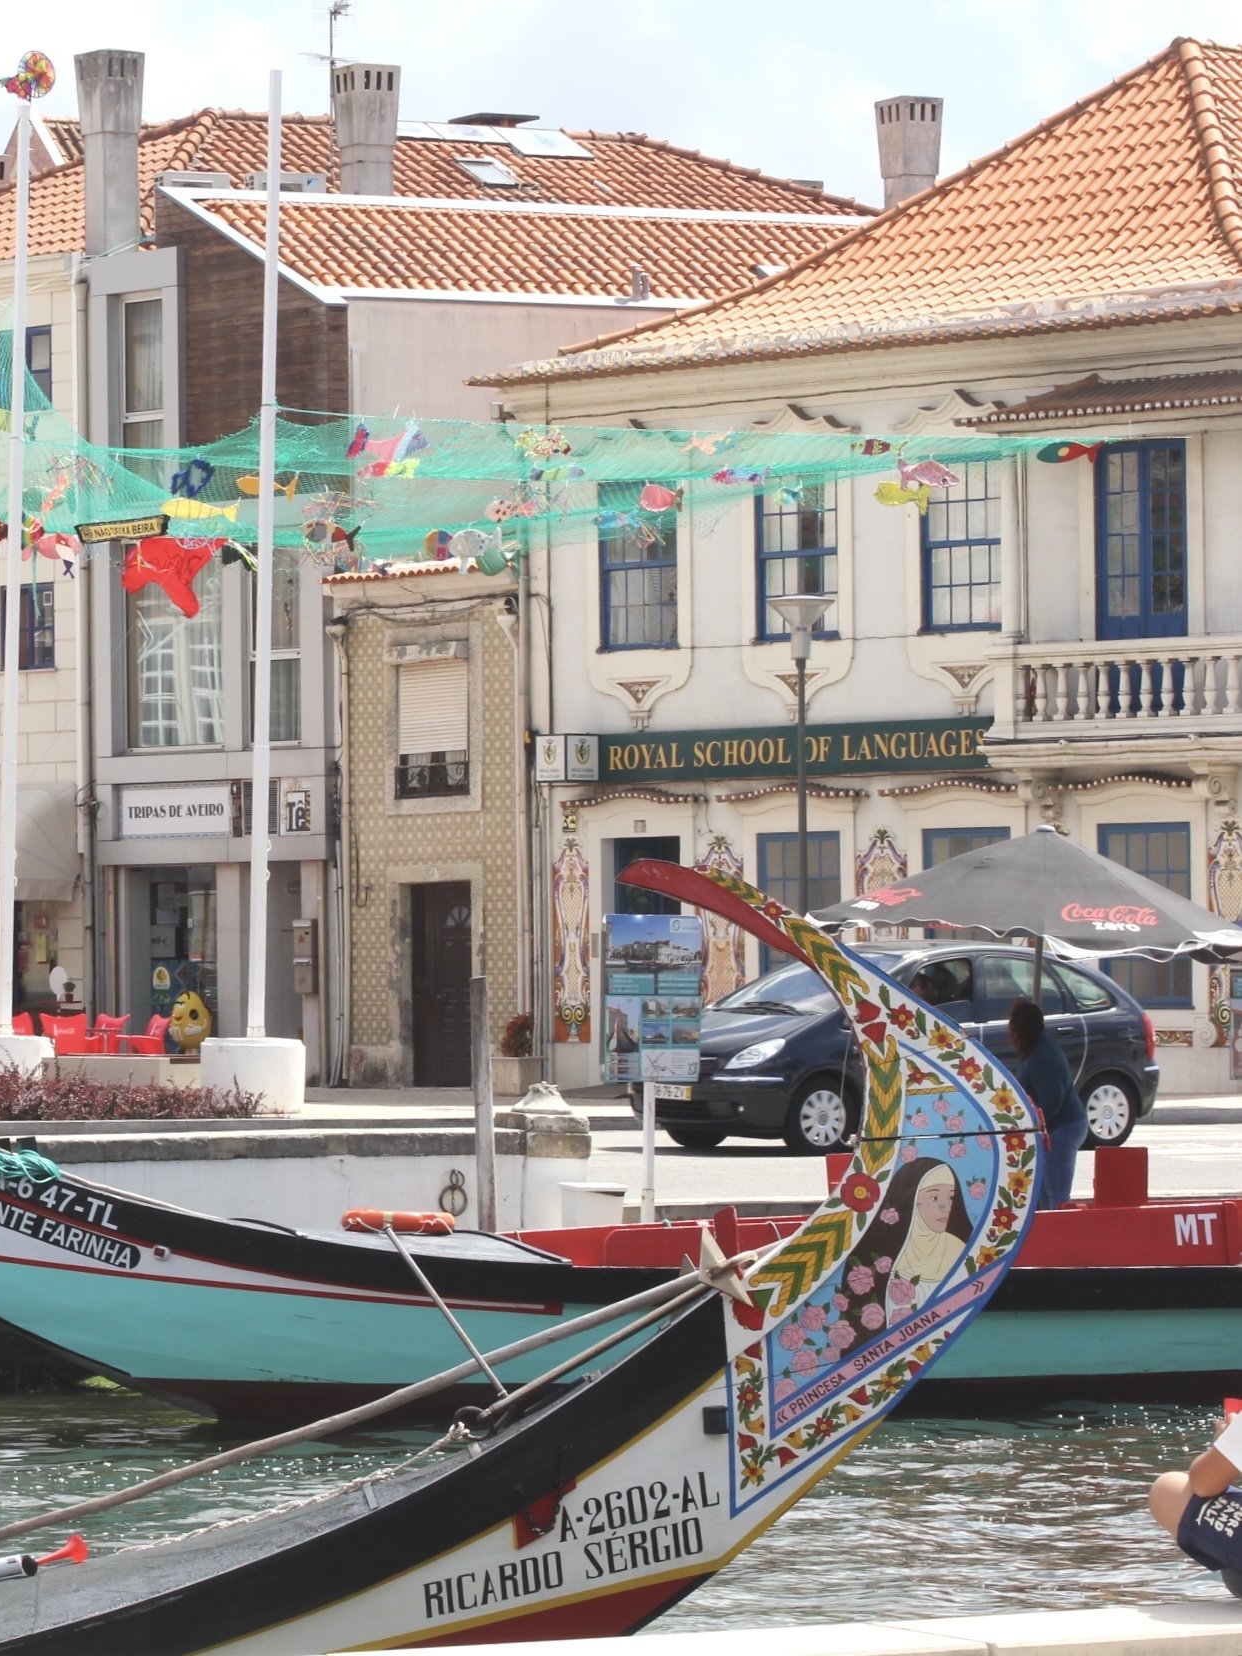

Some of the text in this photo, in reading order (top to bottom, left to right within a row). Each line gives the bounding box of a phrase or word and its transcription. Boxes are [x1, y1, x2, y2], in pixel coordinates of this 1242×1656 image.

[131, 522, 156, 535] BEIRA
[608, 728, 987, 771] ROYAL SCHOOL OF LANGUAGES
[127, 802, 224, 819] TRIPAS DE AVEIRO
[1061, 903, 1158, 926] Coca-Cola
[39, 1185, 119, 1231] 47-TL
[38, 1218, 133, 1270] FARINHA
[1173, 1212, 1218, 1247] MT
[790, 1373, 847, 1416] PRINCESA
[853, 1340, 895, 1372] SANTA
[899, 1311, 941, 1343] JOANA
[558, 1471, 721, 1544] A-2602-AL
[1203, 1496, 1228, 1526] SALT
[1215, 1501, 1240, 1532] SAND
[1225, 1505, 1242, 1538] URF
[423, 1517, 704, 1619] RICARDO SÉRGIO
